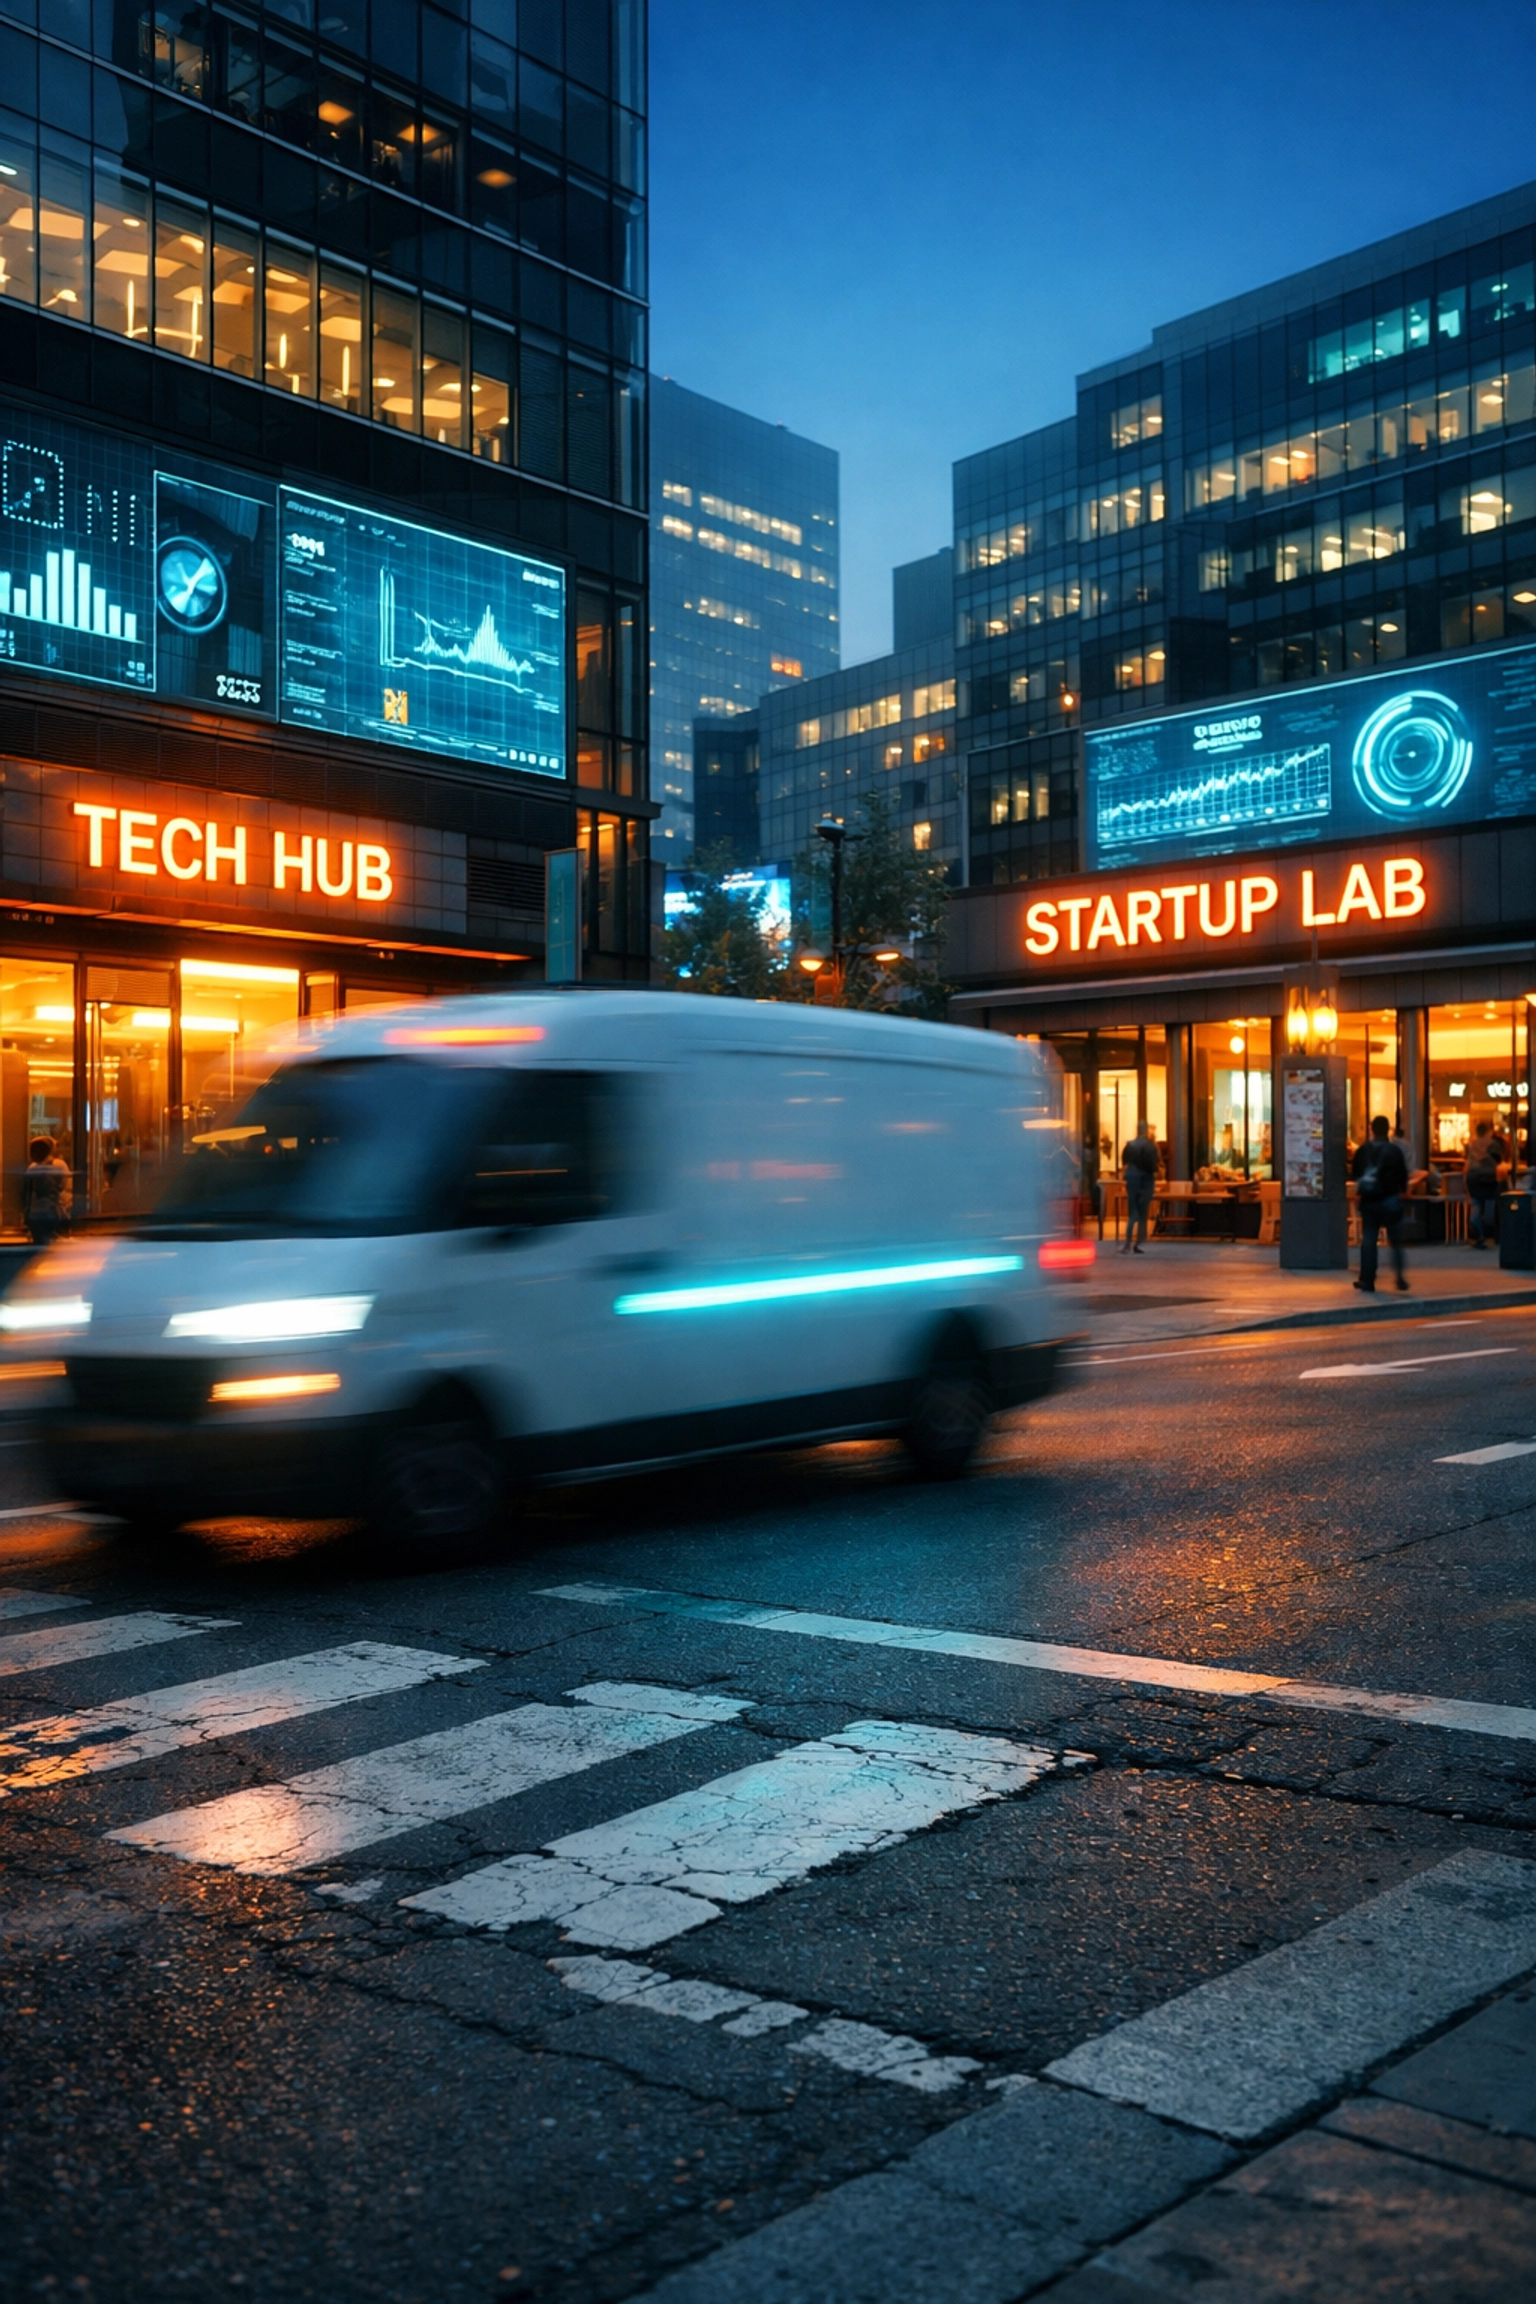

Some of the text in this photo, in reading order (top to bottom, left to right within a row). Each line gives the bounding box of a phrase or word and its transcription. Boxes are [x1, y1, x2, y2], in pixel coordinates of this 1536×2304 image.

[73, 802, 394, 901] TECH HUB
[1025, 858, 1426, 955] STARTUP LAB
